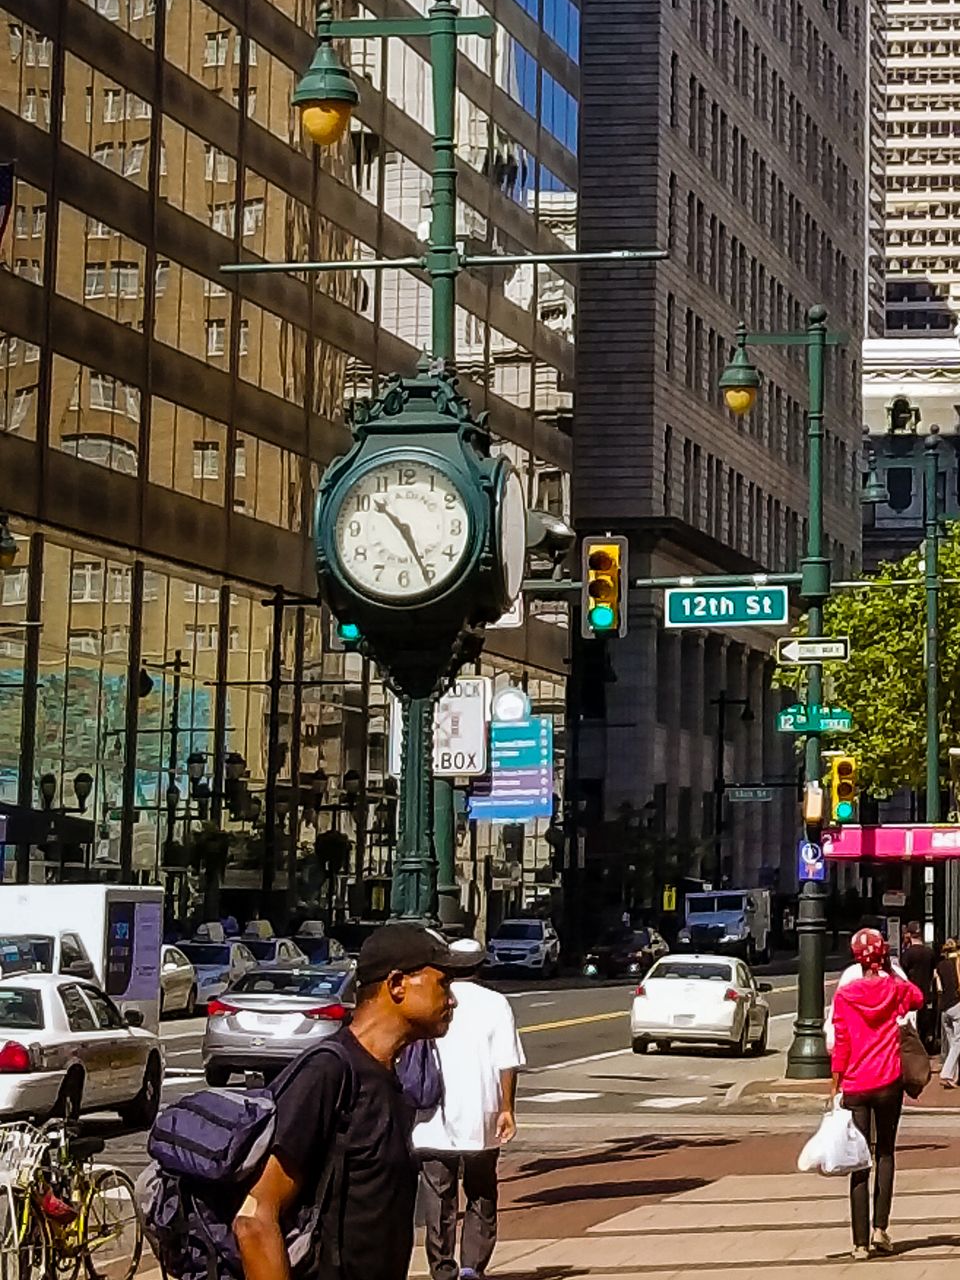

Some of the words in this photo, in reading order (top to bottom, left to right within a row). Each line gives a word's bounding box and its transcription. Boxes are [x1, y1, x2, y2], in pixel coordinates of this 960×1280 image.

[376, 476, 388, 493] 11
[397, 469, 416, 486] 12
[429, 475, 435, 492] 1
[355, 494, 371, 512] 10
[444, 493, 457, 510] 2
[349, 521, 361, 537] 9
[450, 519, 462, 536] 3
[354, 546, 367, 561] 8
[442, 544, 457, 562] 4
[373, 565, 385, 582] 7
[398, 570, 410, 588] 6
[682, 596, 734, 616] 12th
[746, 595, 772, 615] St
[441, 751, 477, 770] BOX
